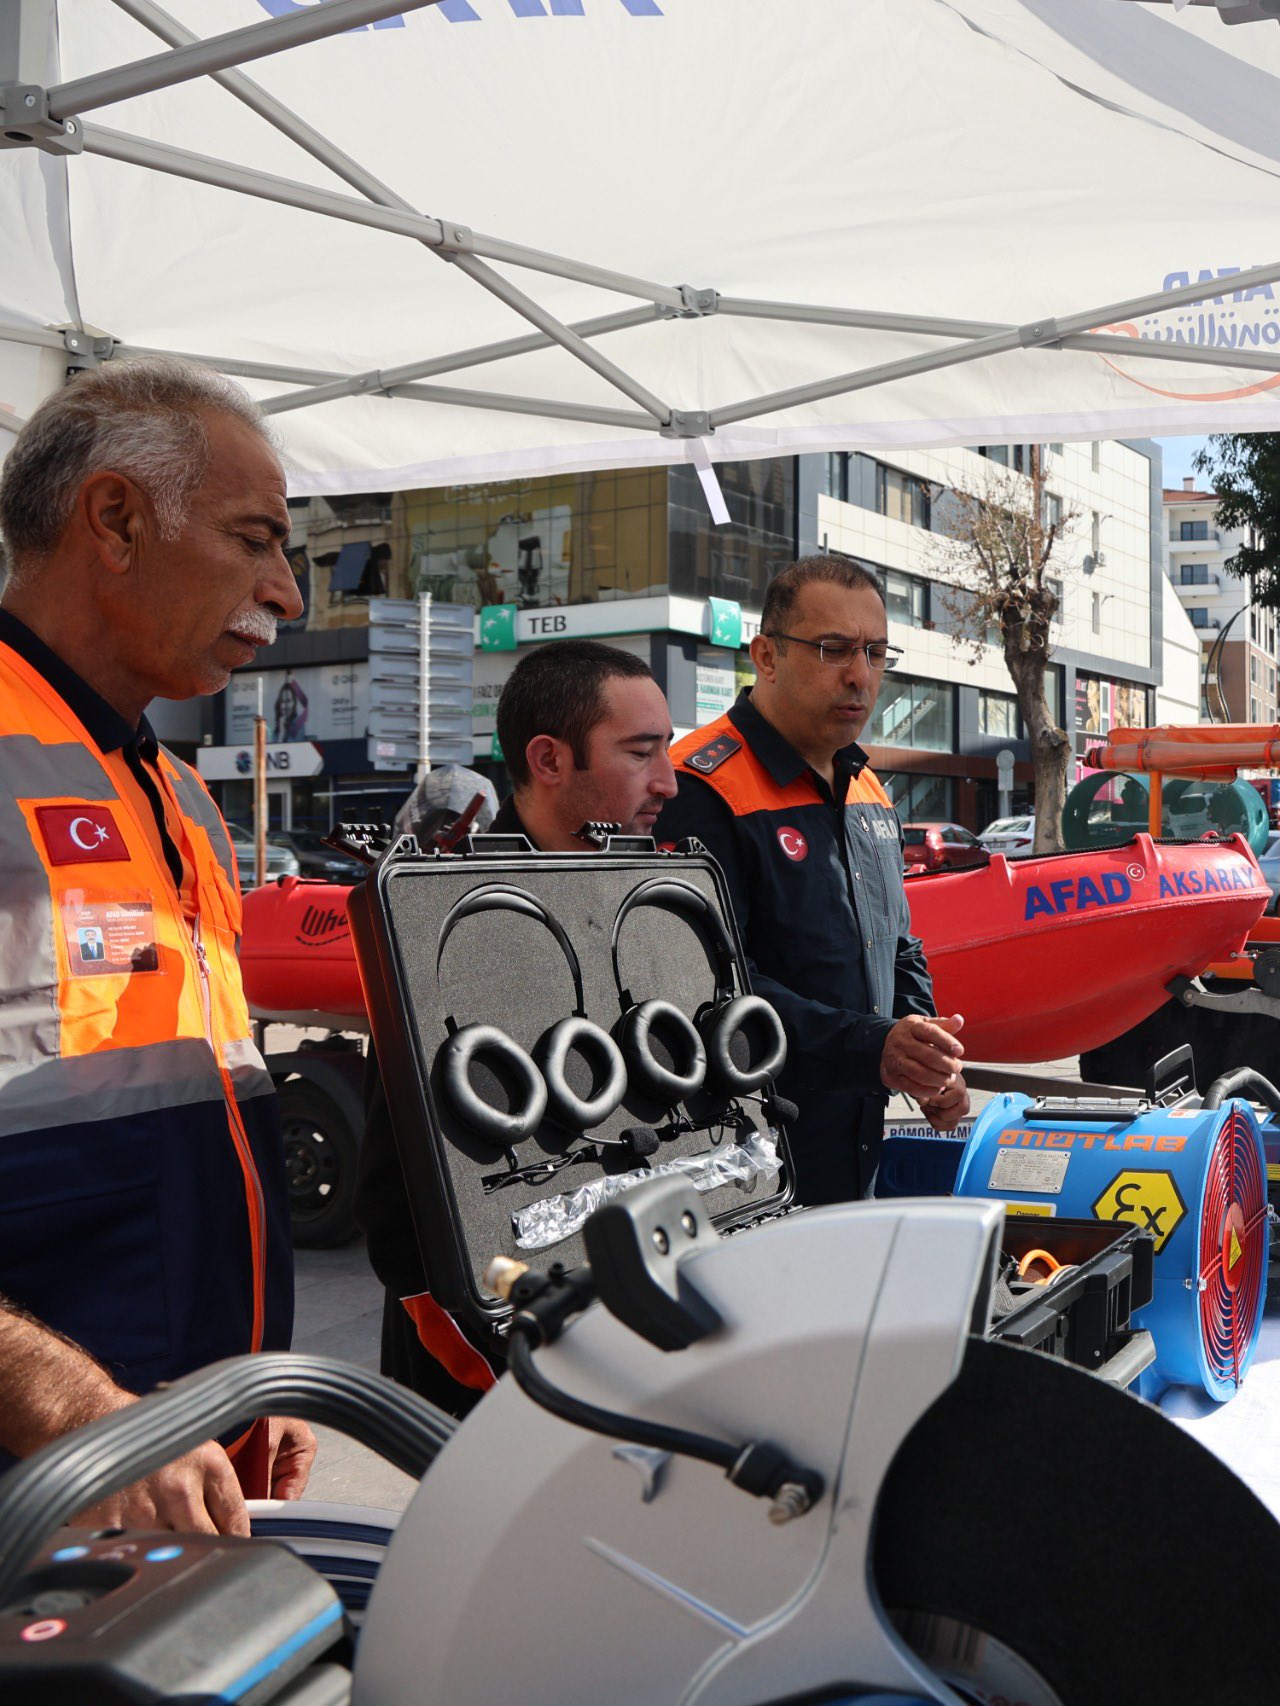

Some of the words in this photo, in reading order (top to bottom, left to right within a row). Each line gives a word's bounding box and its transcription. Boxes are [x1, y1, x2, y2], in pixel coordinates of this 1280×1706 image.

[528, 614, 567, 634] TEB
[744, 621, 761, 637] TE
[1024, 872, 1132, 920] AFAD
[1159, 867, 1257, 899] AKSARAY
